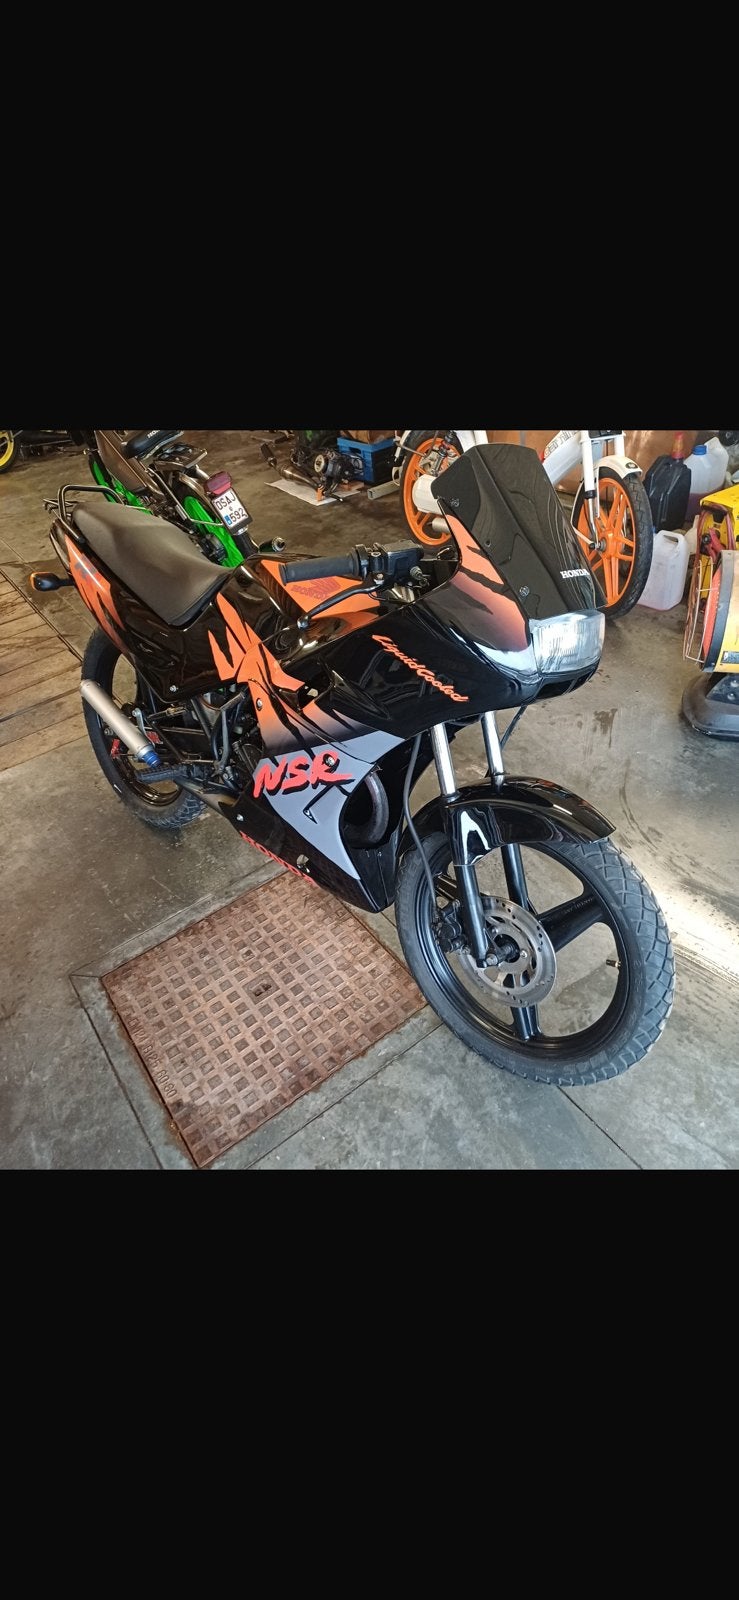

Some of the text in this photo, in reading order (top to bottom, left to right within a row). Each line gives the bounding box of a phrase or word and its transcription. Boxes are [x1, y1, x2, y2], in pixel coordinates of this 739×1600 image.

[229, 508, 248, 523] 592
[560, 568, 590, 579] HONDA
[252, 749, 354, 799] NSR
